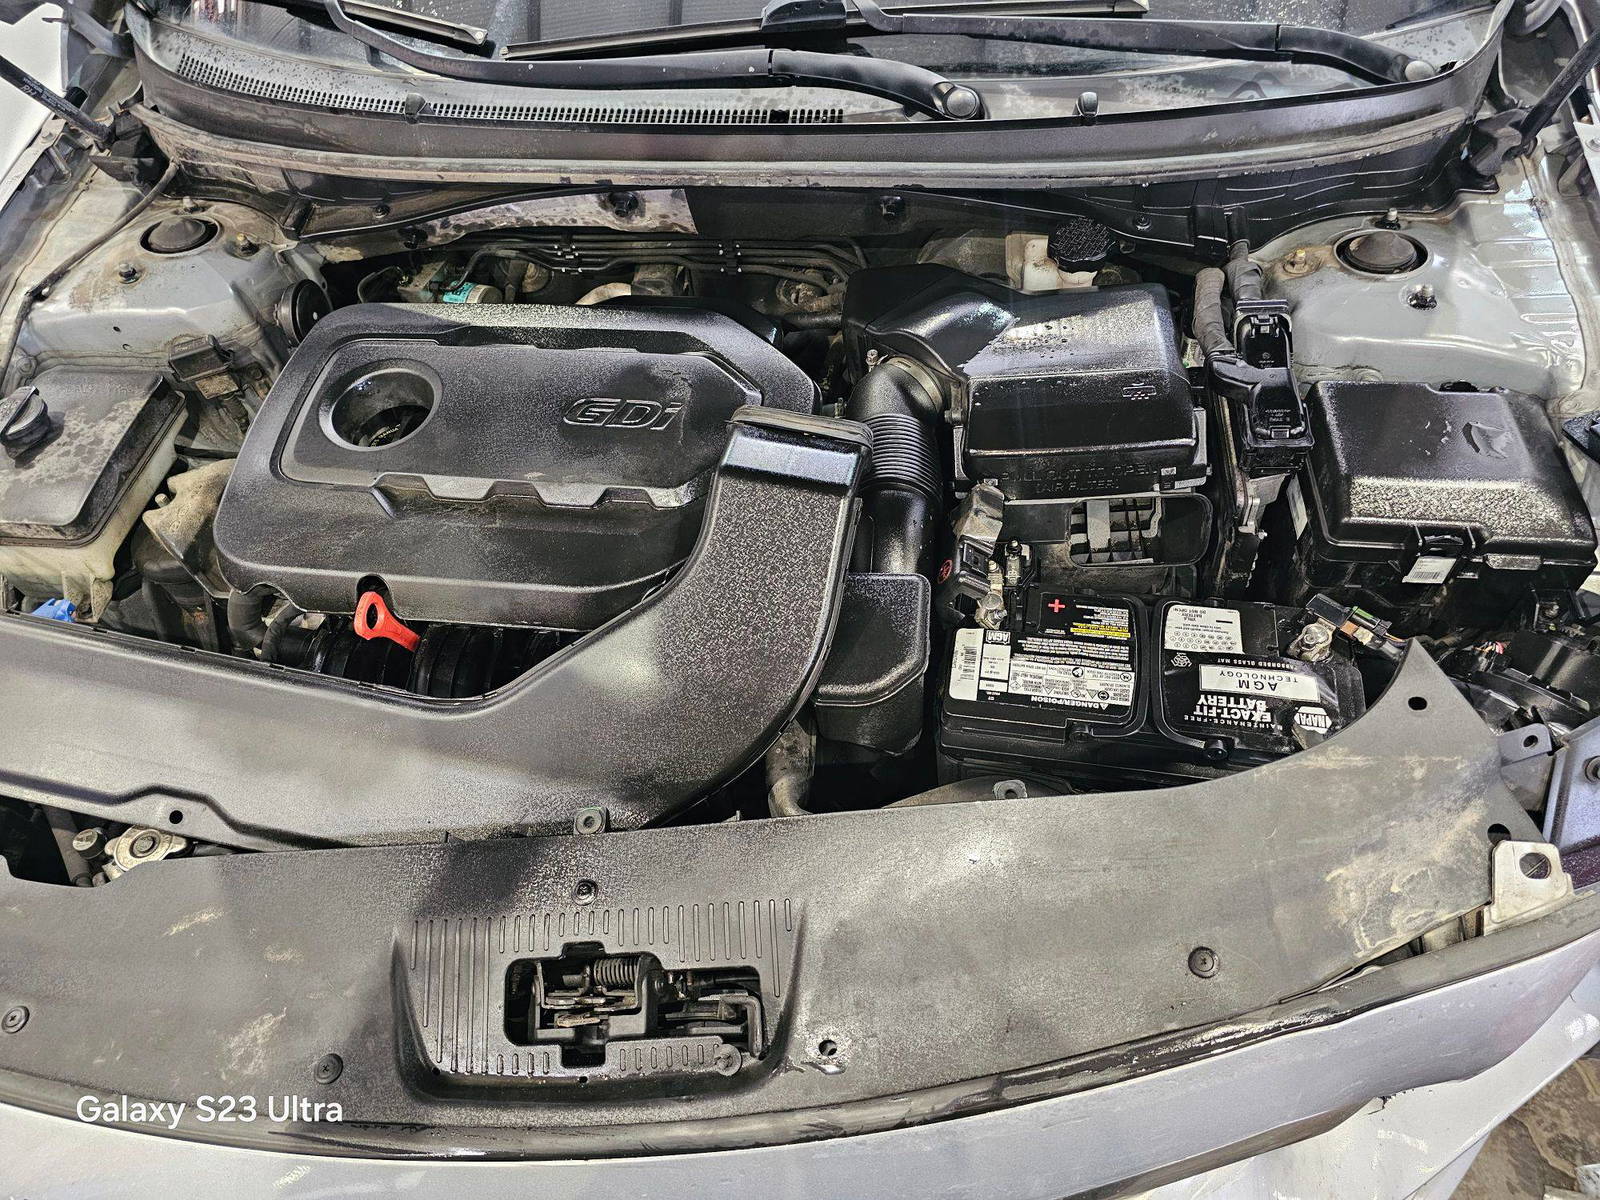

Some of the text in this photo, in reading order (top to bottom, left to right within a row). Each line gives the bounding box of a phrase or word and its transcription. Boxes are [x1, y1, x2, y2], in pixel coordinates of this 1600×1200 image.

[987, 632, 1009, 643] AGM
[1219, 670, 1298, 683] TECHNOLOGY
[1238, 679, 1278, 692] AGM
[1031, 695, 1099, 709] DANGER/POISON
[1197, 694, 1266, 710] BATTERY
[1193, 705, 1271, 722] EXACT-FIT
[1298, 712, 1326, 728] NAPA
[1183, 714, 1283, 730] MAINTENANCE-FREE
